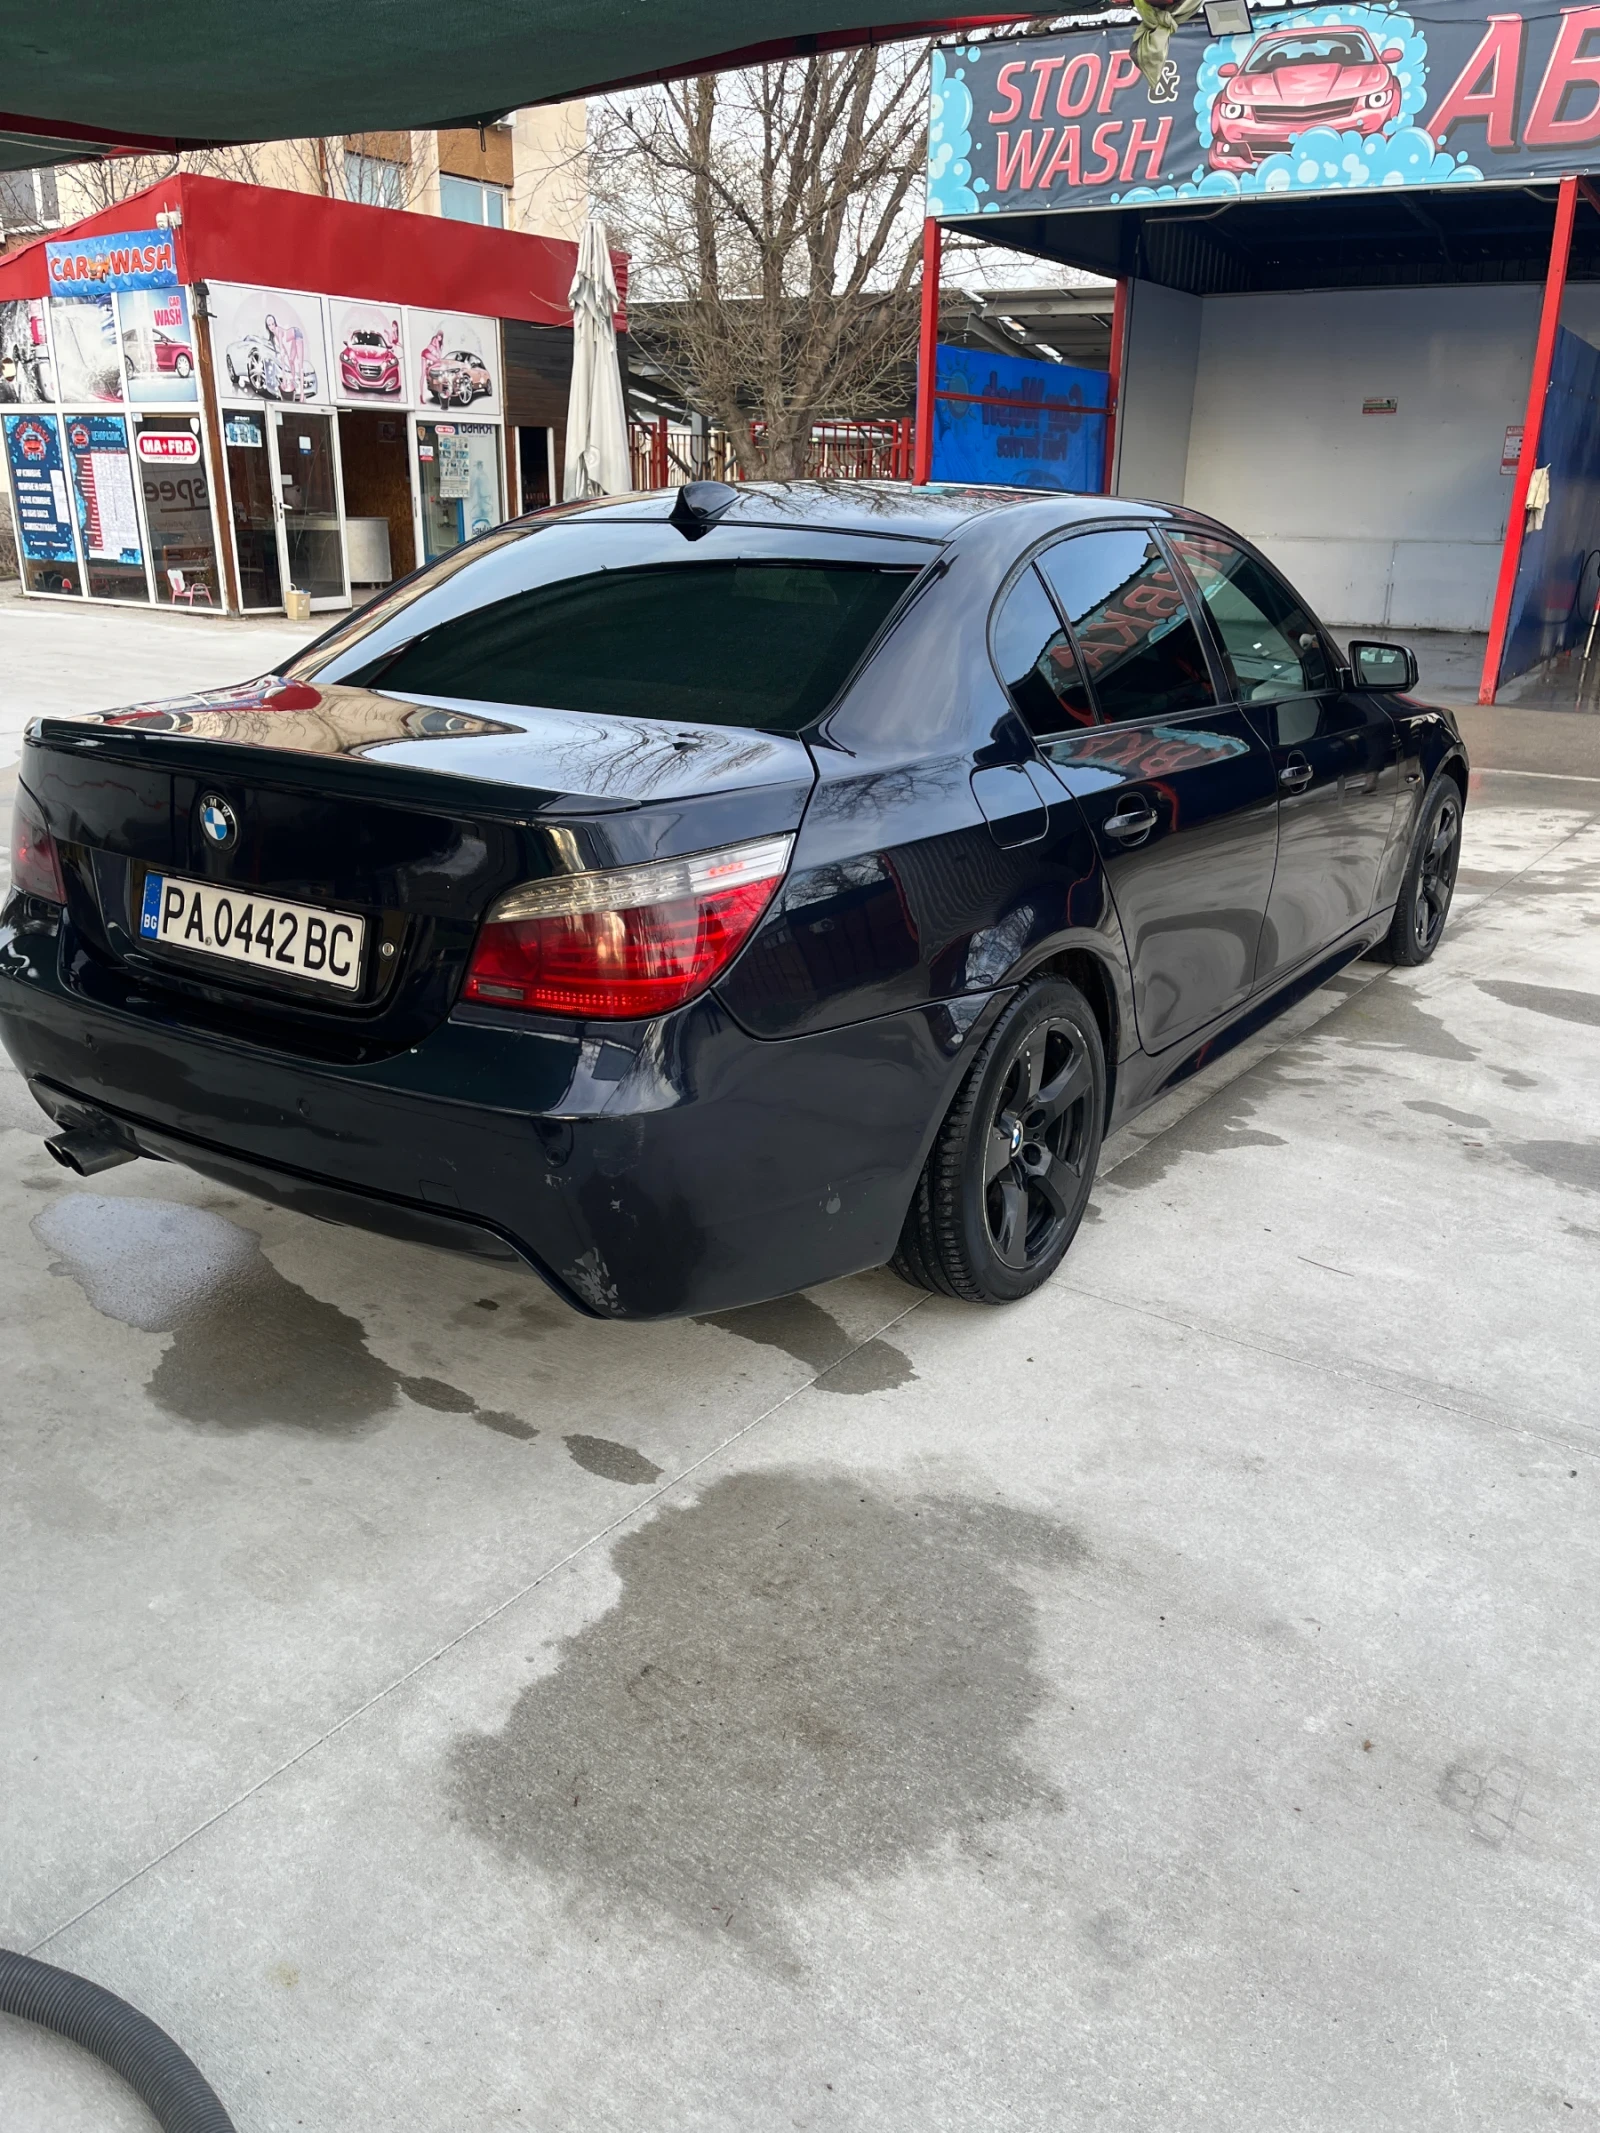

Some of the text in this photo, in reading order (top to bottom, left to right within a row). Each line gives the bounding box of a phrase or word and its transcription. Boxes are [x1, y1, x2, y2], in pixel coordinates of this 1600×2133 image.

[988, 49, 1180, 124] STOP &
[996, 116, 1173, 191] WASH
[51, 243, 172, 282] CAR WASH
[168, 295, 181, 307] CAR
[153, 308, 183, 326] WASH
[143, 912, 158, 930] BG
